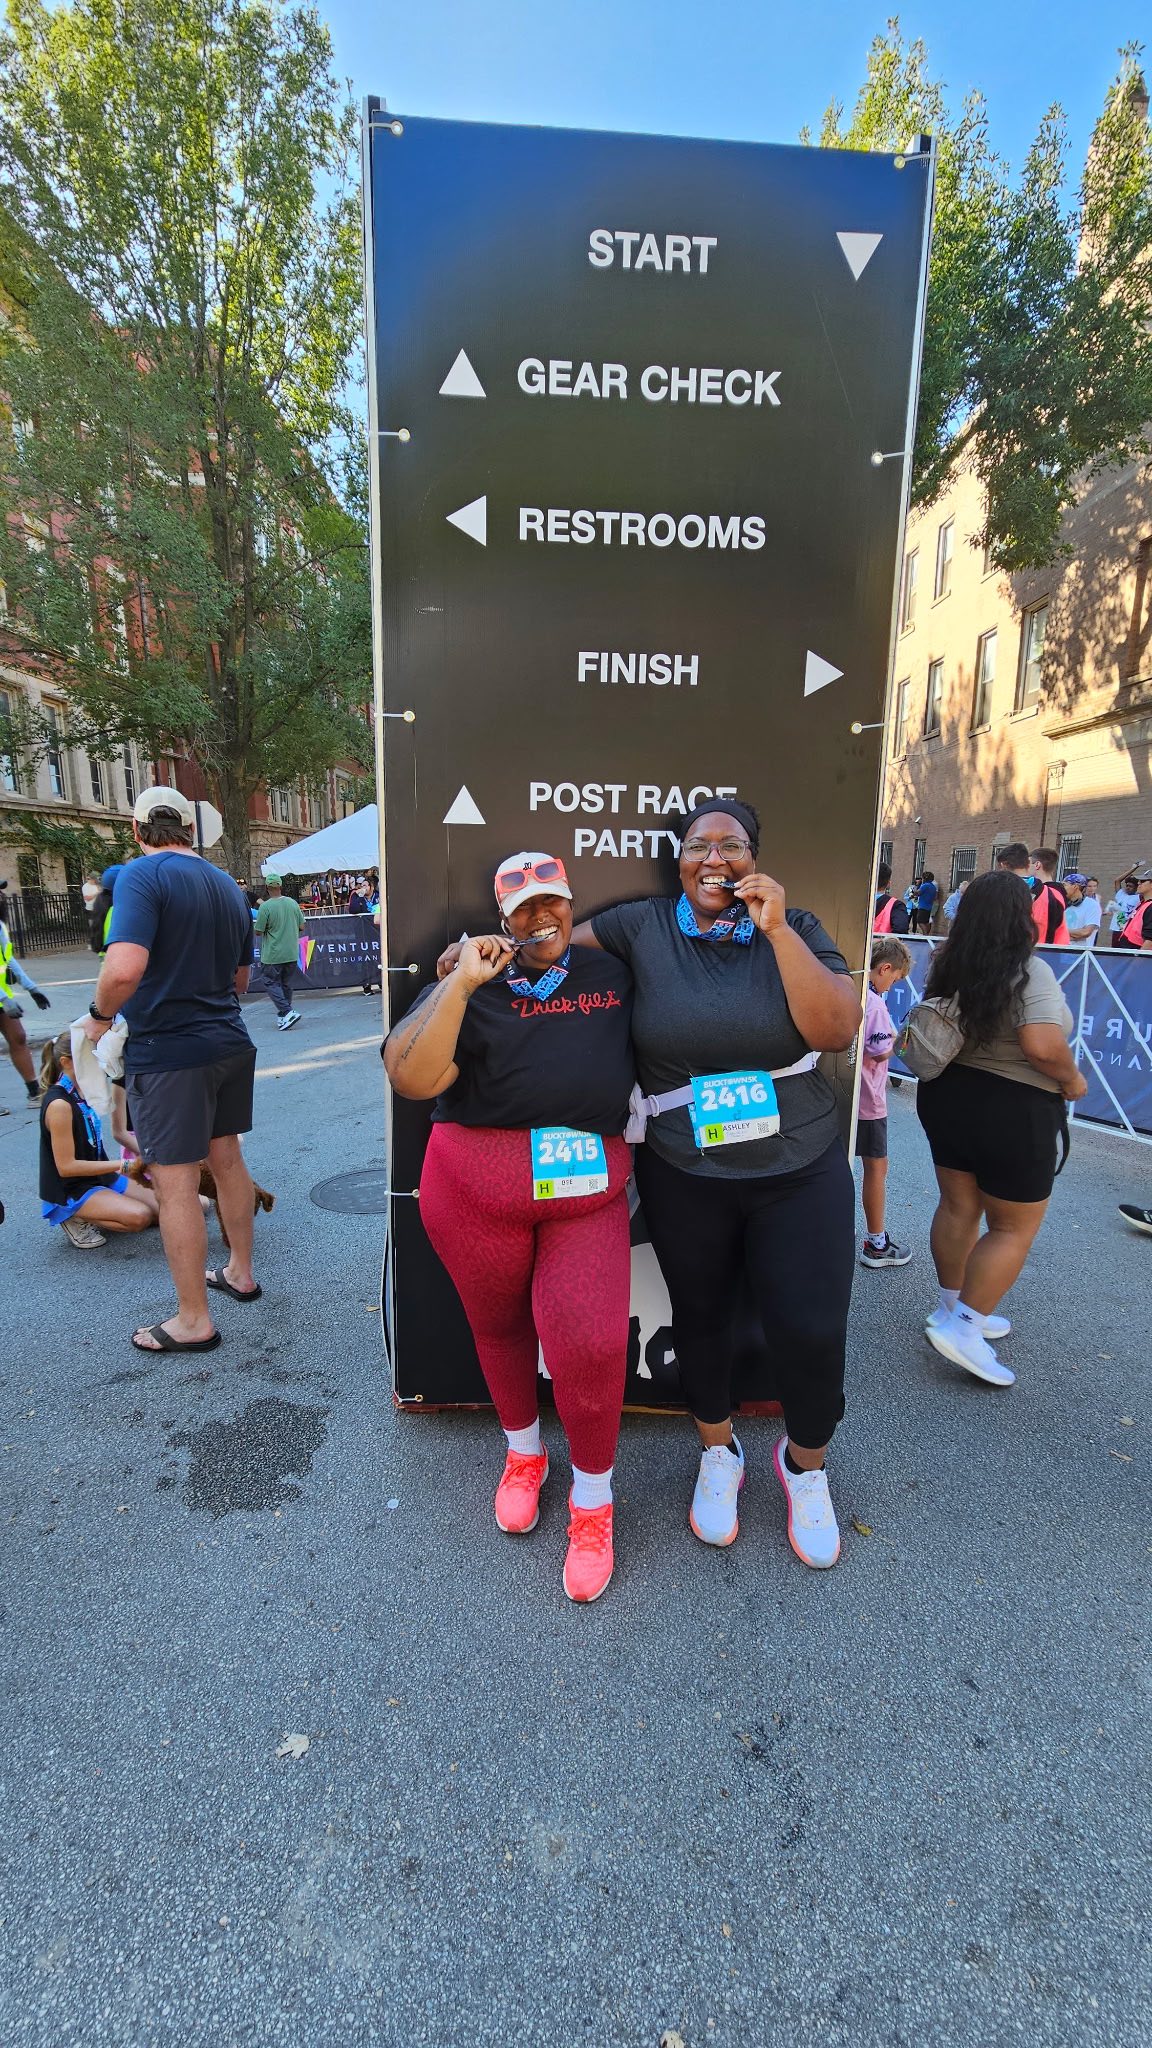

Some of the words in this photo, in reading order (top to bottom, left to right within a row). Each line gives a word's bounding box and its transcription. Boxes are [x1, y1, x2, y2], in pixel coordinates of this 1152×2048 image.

[588, 230, 717, 273] START
[517, 358, 627, 399] GEAR
[640, 365, 782, 406] CHECK
[519, 508, 766, 549] RESTROOMS
[578, 652, 699, 686] FINISH
[529, 782, 627, 814] POST
[701, 1083, 768, 1112] 2416
[708, 1128, 718, 1140] H
[722, 1122, 751, 1132] ASHLEY
[539, 1138, 599, 1164] 2415
[540, 1183, 549, 1194] H
